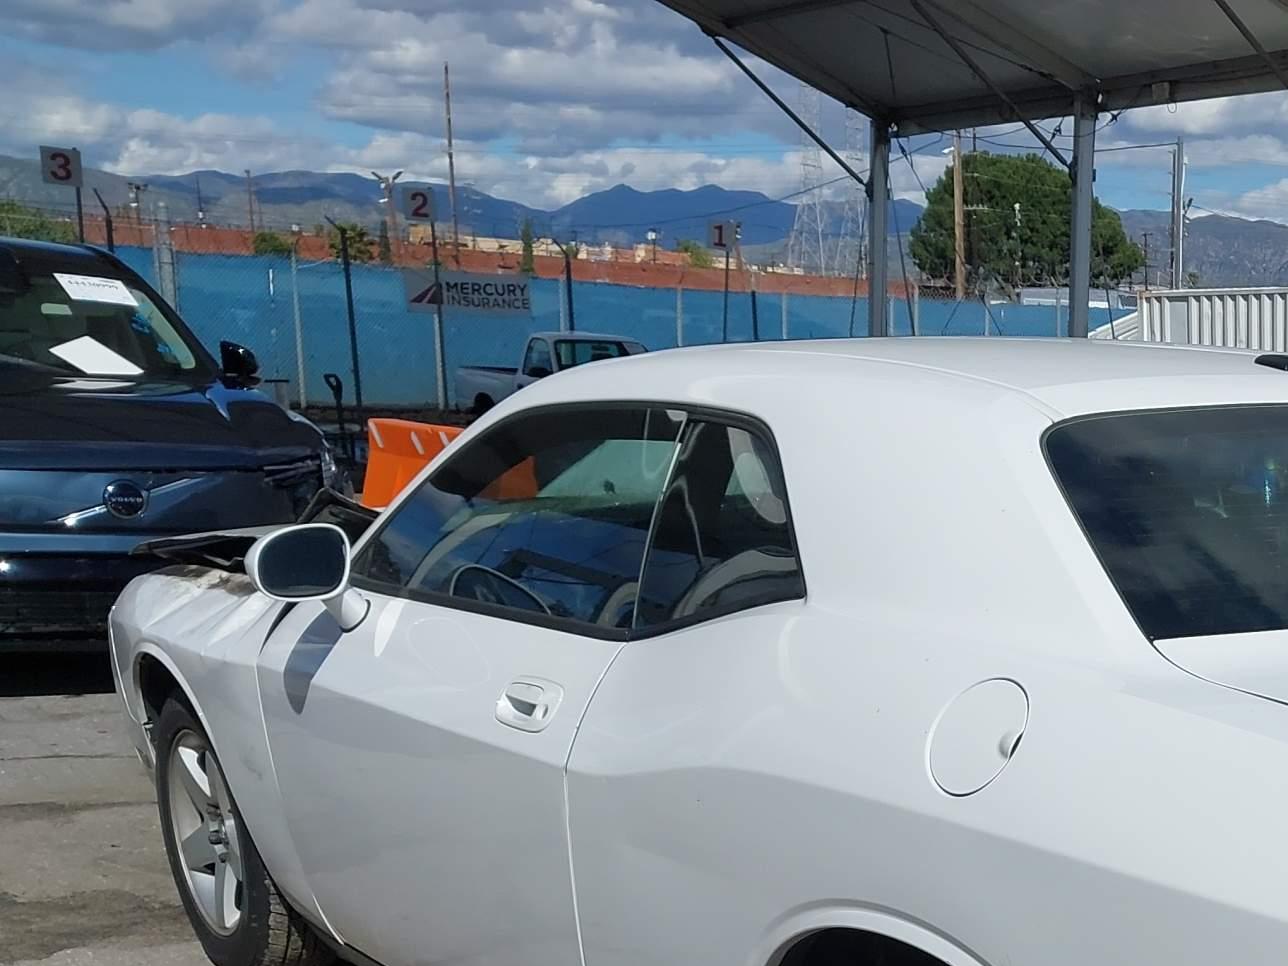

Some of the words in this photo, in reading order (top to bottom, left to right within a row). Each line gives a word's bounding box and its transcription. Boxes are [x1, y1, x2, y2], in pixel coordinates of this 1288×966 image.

[49, 152, 72, 181] 3
[410, 191, 431, 218] 2
[713, 224, 727, 247] 1
[445, 281, 528, 297] MERCURY
[446, 295, 530, 310] INSURANCE
